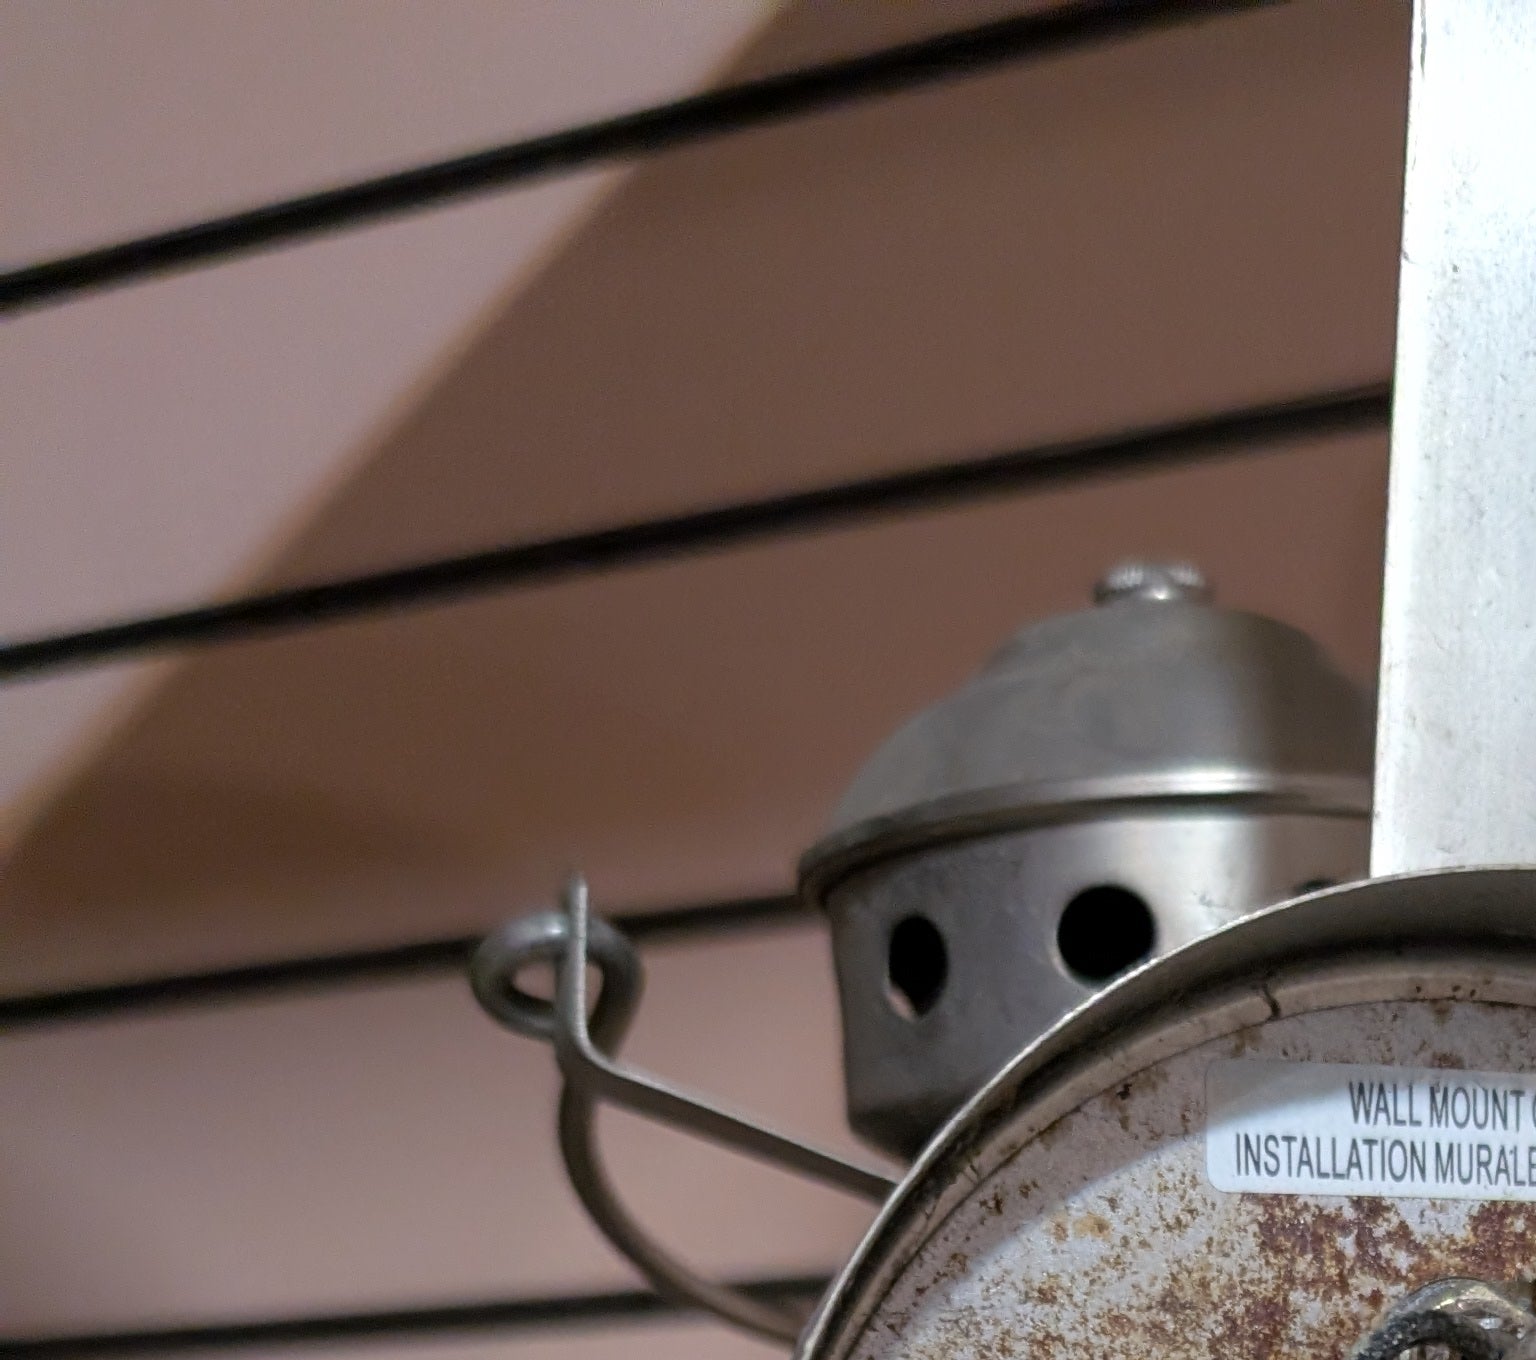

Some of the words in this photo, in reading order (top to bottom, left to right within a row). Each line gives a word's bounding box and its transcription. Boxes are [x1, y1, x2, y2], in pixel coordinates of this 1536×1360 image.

[1348, 1080, 1422, 1129] WALL
[1429, 1081, 1522, 1133] MOUNT
[1235, 1132, 1427, 1184] INSTALLATION
